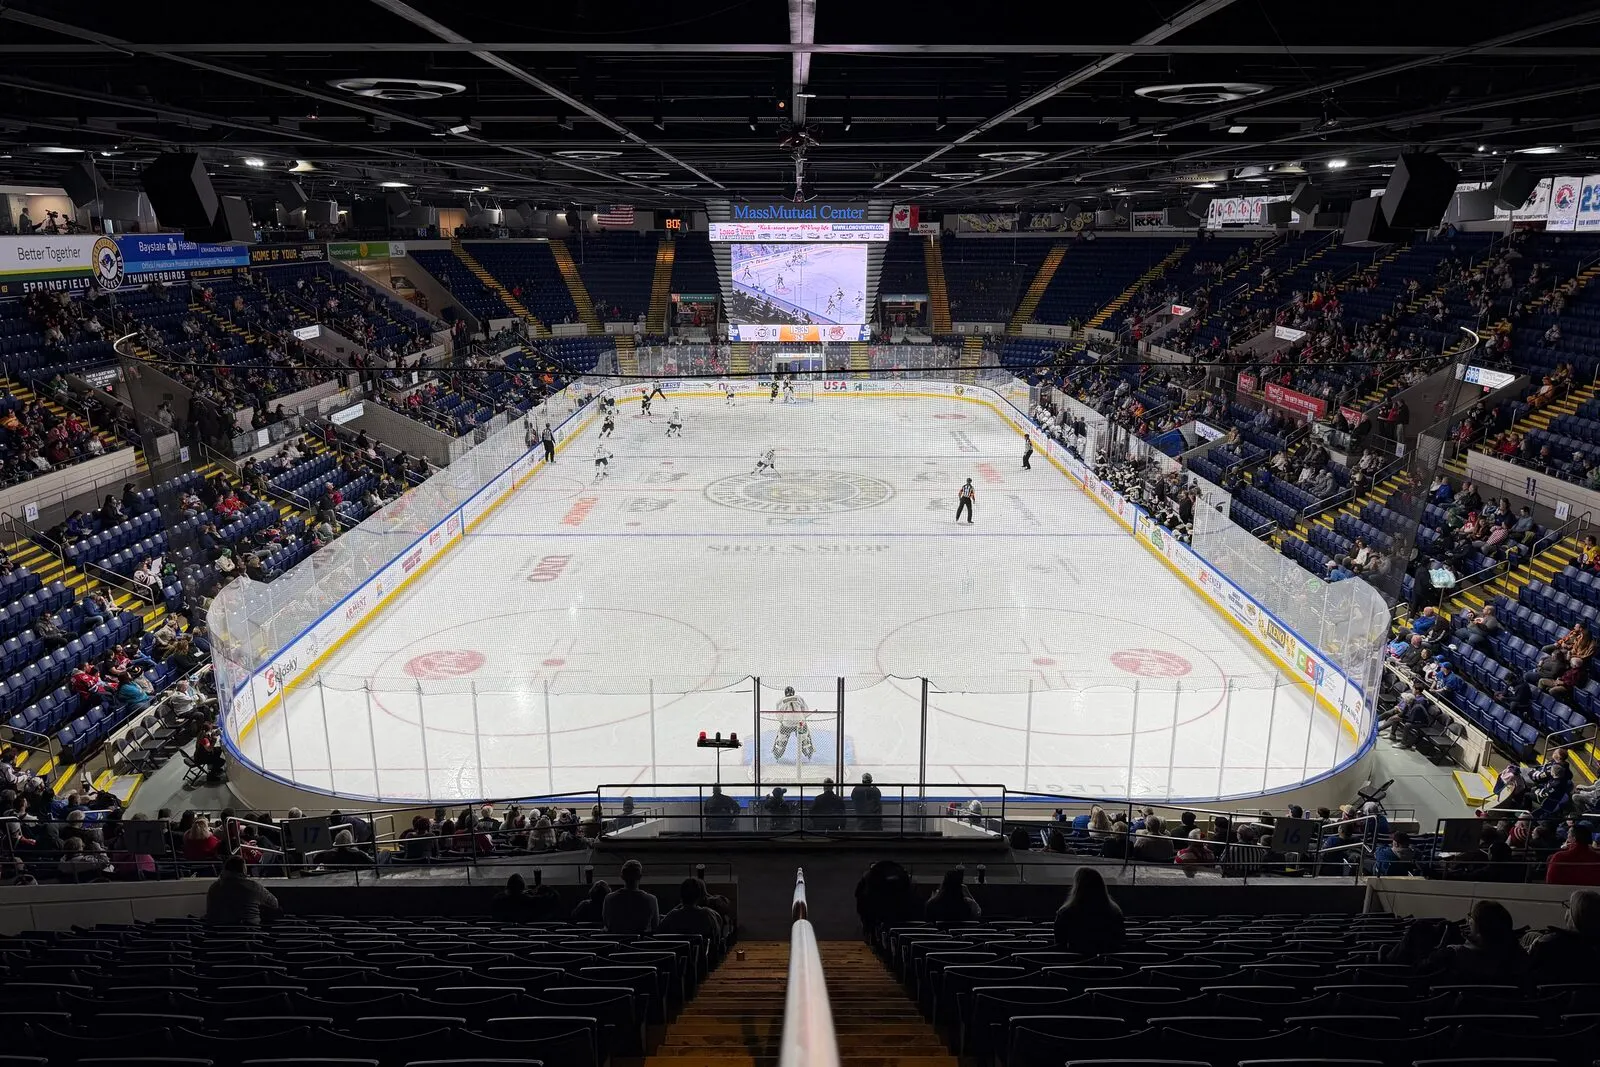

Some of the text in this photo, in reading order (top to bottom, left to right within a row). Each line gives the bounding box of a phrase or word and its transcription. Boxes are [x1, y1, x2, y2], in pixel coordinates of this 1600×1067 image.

[734, 205, 864, 219] MassMutual Center
[17, 245, 81, 263] Better Together
[138, 241, 197, 254] Baystate Health
[252, 252, 270, 261] HOME
[271, 251, 280, 261] OF
[282, 250, 298, 260] YOUR
[100, 276, 120, 289] HOCKEY
[127, 271, 186, 284] THUNDERBIRDS
[23, 278, 91, 293] SPRINGFIELD
[823, 382, 847, 390] USA
[1268, 623, 1285, 644] KENO
[303, 827, 321, 843] 17
[1283, 829, 1300, 844] 16
